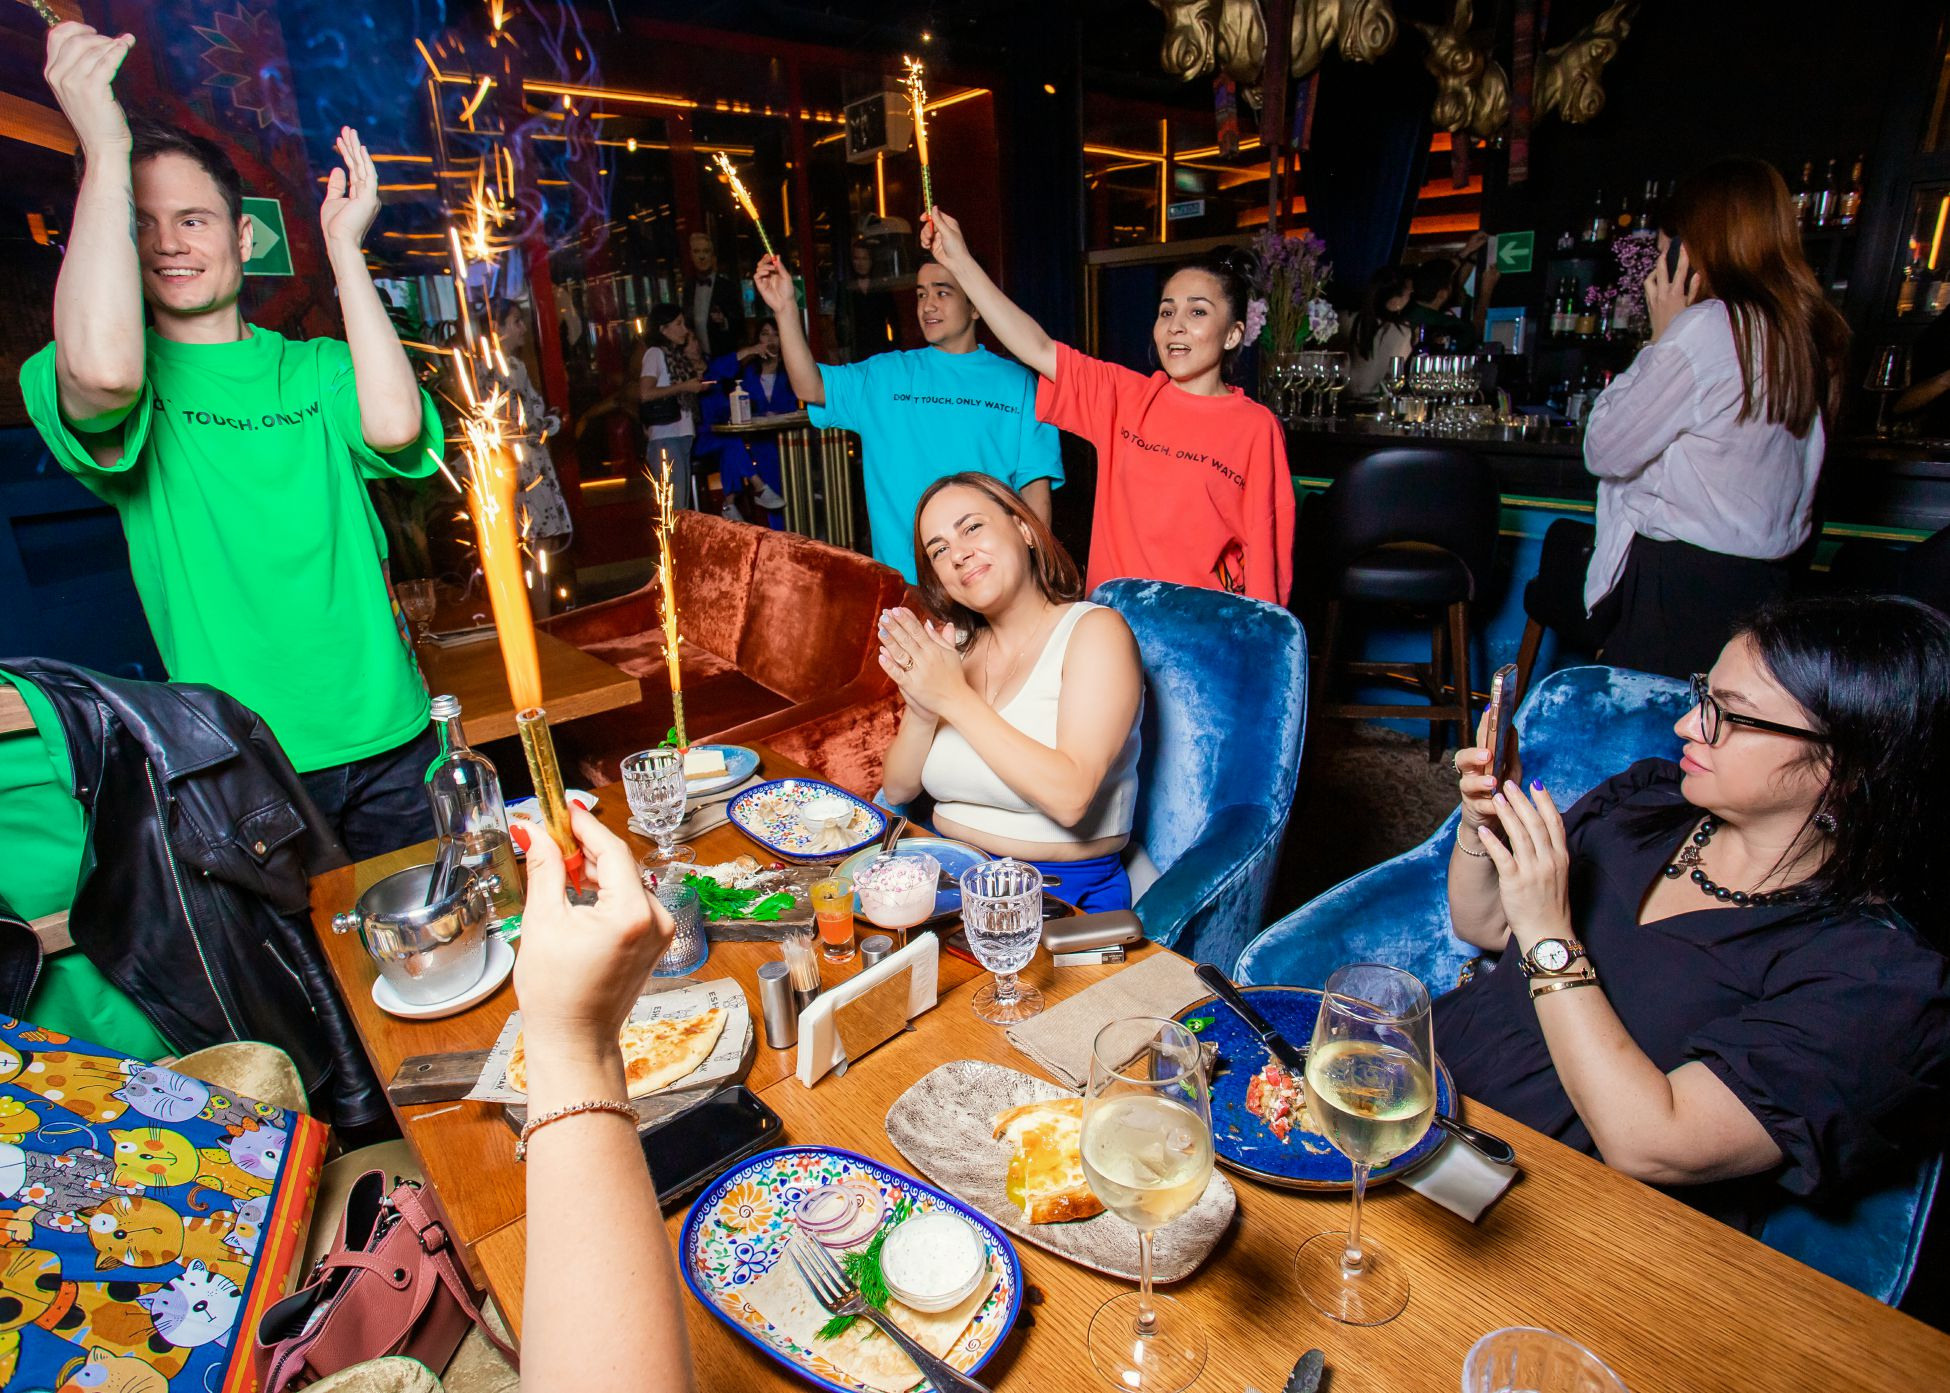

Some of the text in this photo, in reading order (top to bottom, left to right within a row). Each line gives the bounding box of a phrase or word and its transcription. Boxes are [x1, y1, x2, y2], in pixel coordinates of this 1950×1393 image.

[893, 393, 1020, 415] DONT TOUCH. ONLY WATCH.
[182, 410, 259, 431] TOUCH.
[261, 411, 304, 428] ONLY
[1131, 434, 1171, 456] TOUCH.
[1175, 450, 1209, 463] ONLY
